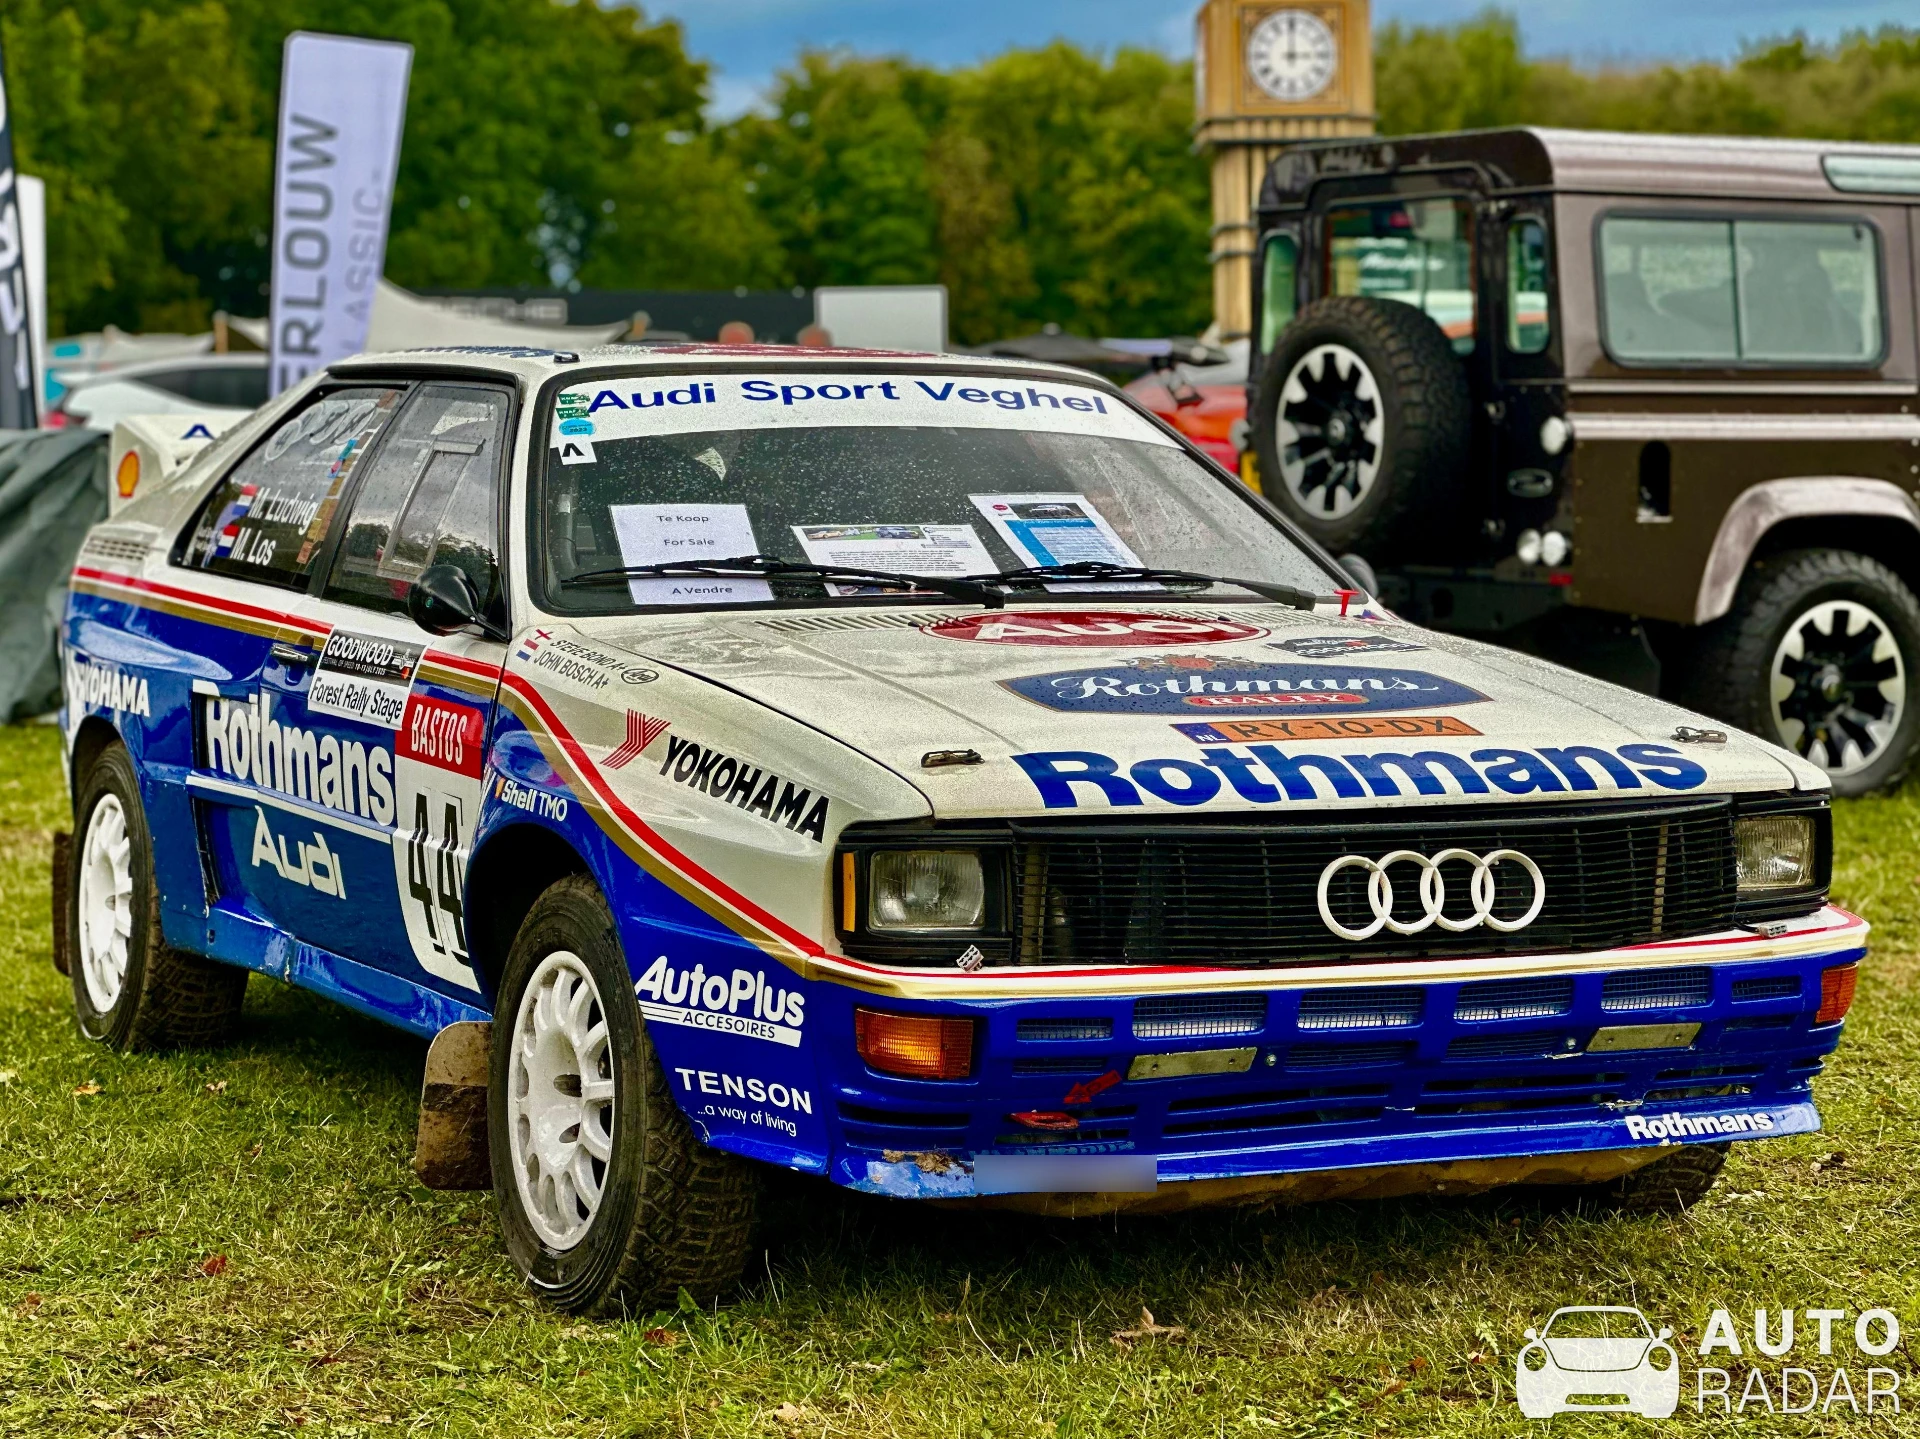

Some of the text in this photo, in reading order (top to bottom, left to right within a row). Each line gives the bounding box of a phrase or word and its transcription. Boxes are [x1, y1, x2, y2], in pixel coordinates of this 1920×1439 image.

[587, 380, 1108, 414] Audi Sport Veghel
[264, 488, 320, 536] Ludwig
[676, 515, 709, 523] Koop
[230, 527, 277, 566] M. Los
[664, 538, 715, 546] For Sale
[684, 586, 733, 594] Vendre
[327, 635, 394, 666] GOODWOOD
[534, 650, 566, 672] JOHN
[560, 660, 596, 686] BOSCH
[73, 657, 150, 717] KOHAMA
[310, 677, 403, 724] Forest Rally Stage
[1051, 675, 1440, 699] Rothmans
[1209, 694, 1342, 705] RALLY
[411, 703, 468, 765] BASTOS
[1196, 720, 1464, 742] NL RY-10-DX
[192, 679, 395, 827] Rothmans
[658, 735, 833, 844] YOKOHAMA
[1008, 742, 1708, 810] Rothmans
[501, 779, 568, 822] Shell TMO
[251, 805, 347, 899] Audi
[407, 792, 470, 955] 44
[634, 955, 805, 1027] AutoPlus
[683, 1011, 776, 1039] ACCESOIRES
[674, 1067, 813, 1115] TENSON
[718, 1106, 747, 1125] way
[750, 1110, 763, 1126] of
[765, 1111, 797, 1138] living
[1625, 1112, 1774, 1140] Rothmans
